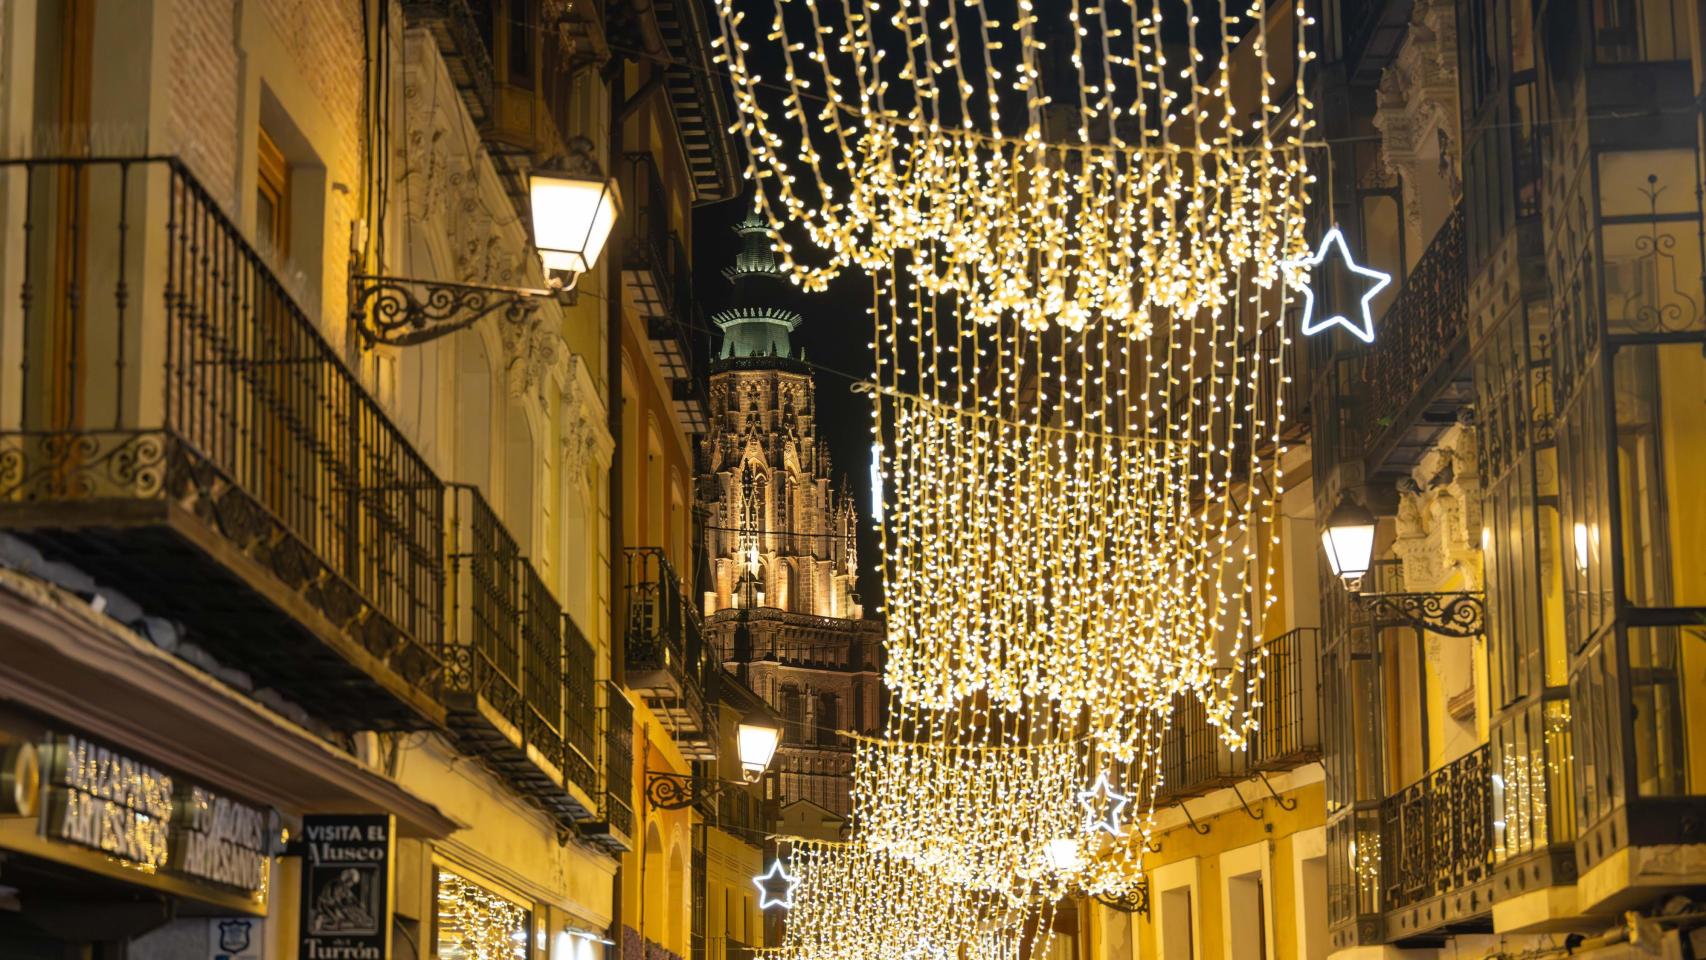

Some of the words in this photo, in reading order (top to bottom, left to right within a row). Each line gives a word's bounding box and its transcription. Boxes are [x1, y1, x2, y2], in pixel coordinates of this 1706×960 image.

[307, 825, 362, 841] VISITA
[367, 826, 386, 841] EL
[308, 842, 384, 867] Museo
[304, 938, 379, 960] Turrón
